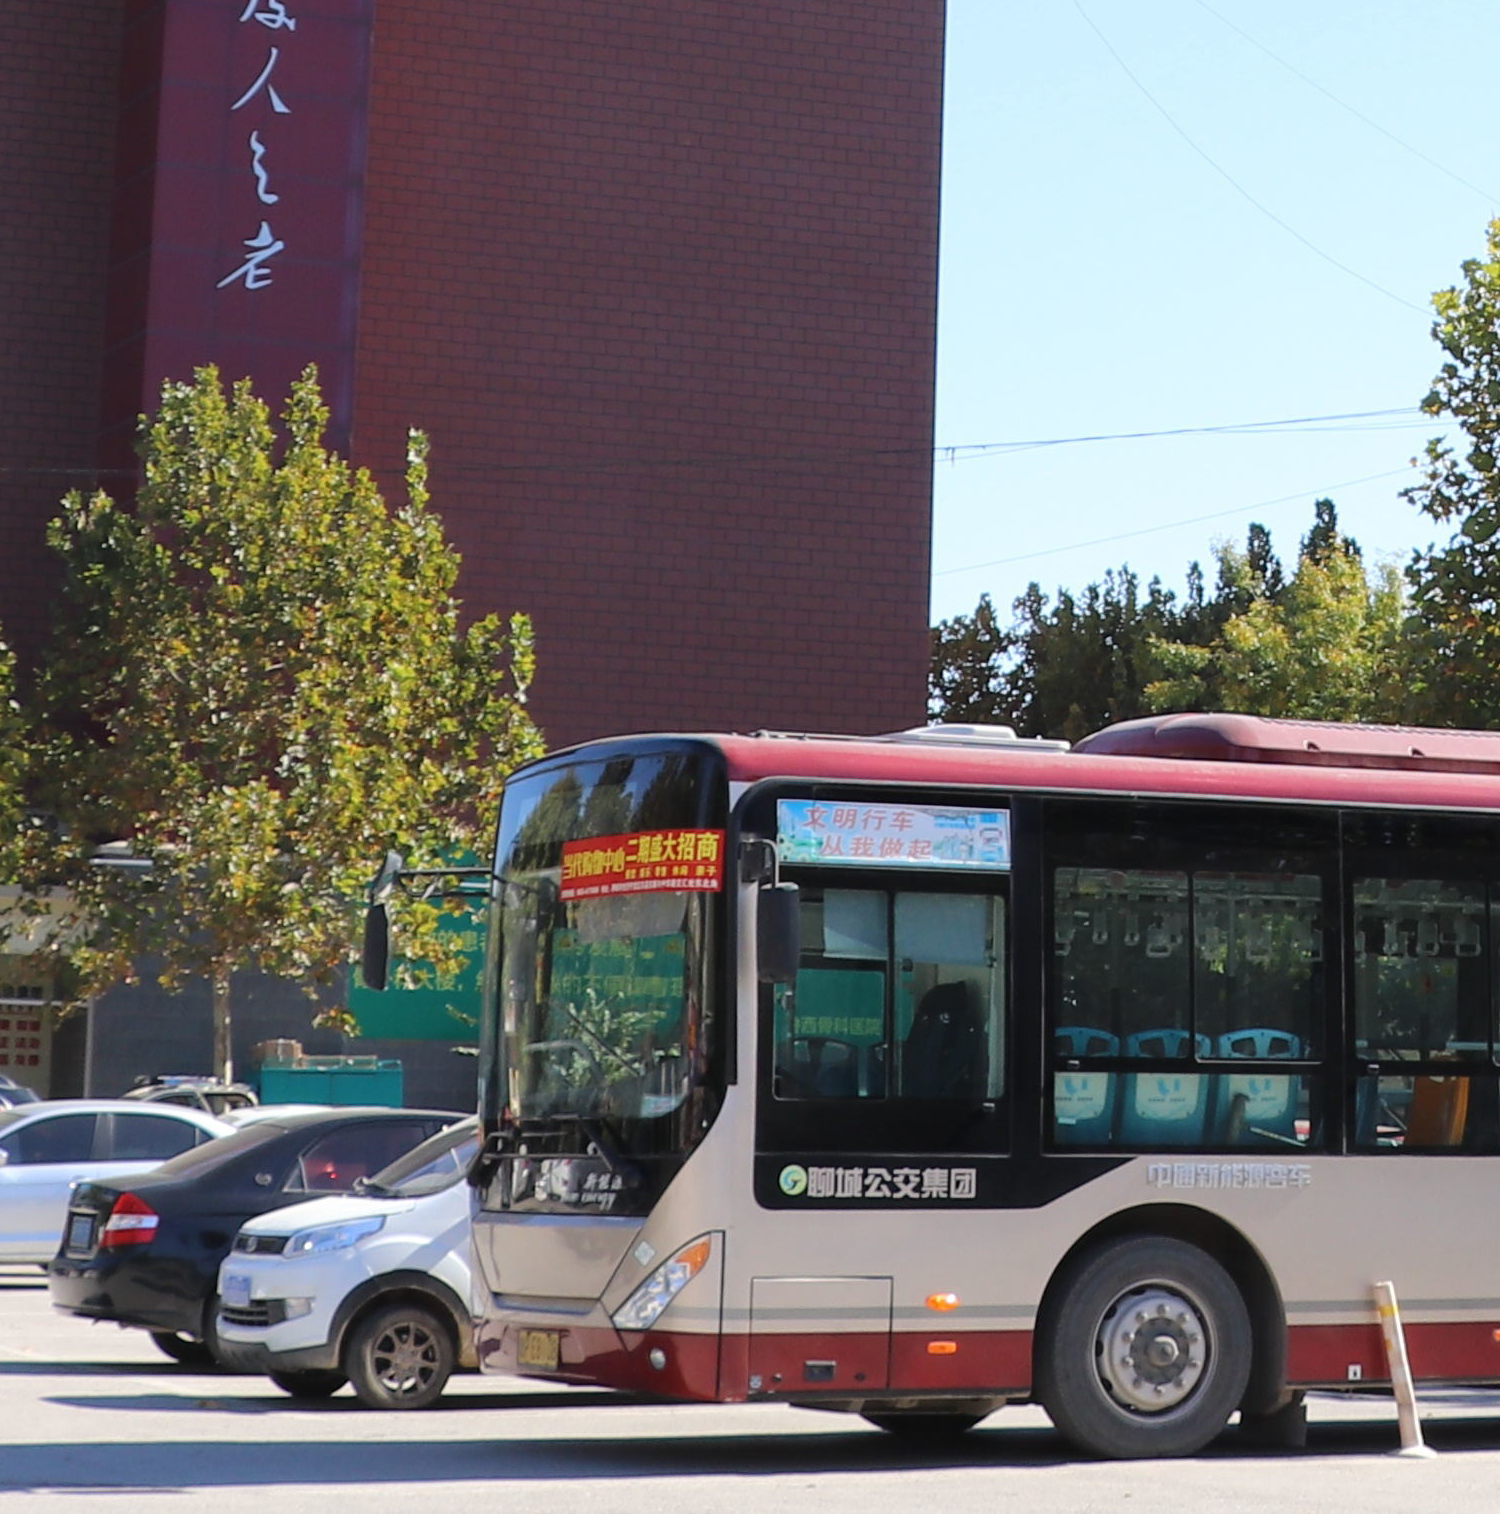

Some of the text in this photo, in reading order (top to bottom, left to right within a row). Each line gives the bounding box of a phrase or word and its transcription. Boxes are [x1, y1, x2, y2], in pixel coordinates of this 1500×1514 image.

[803, 805, 916, 832] 文明行车
[819, 835, 933, 860] 从我做起
[807, 1167, 977, 1199] 聊城公交集团
